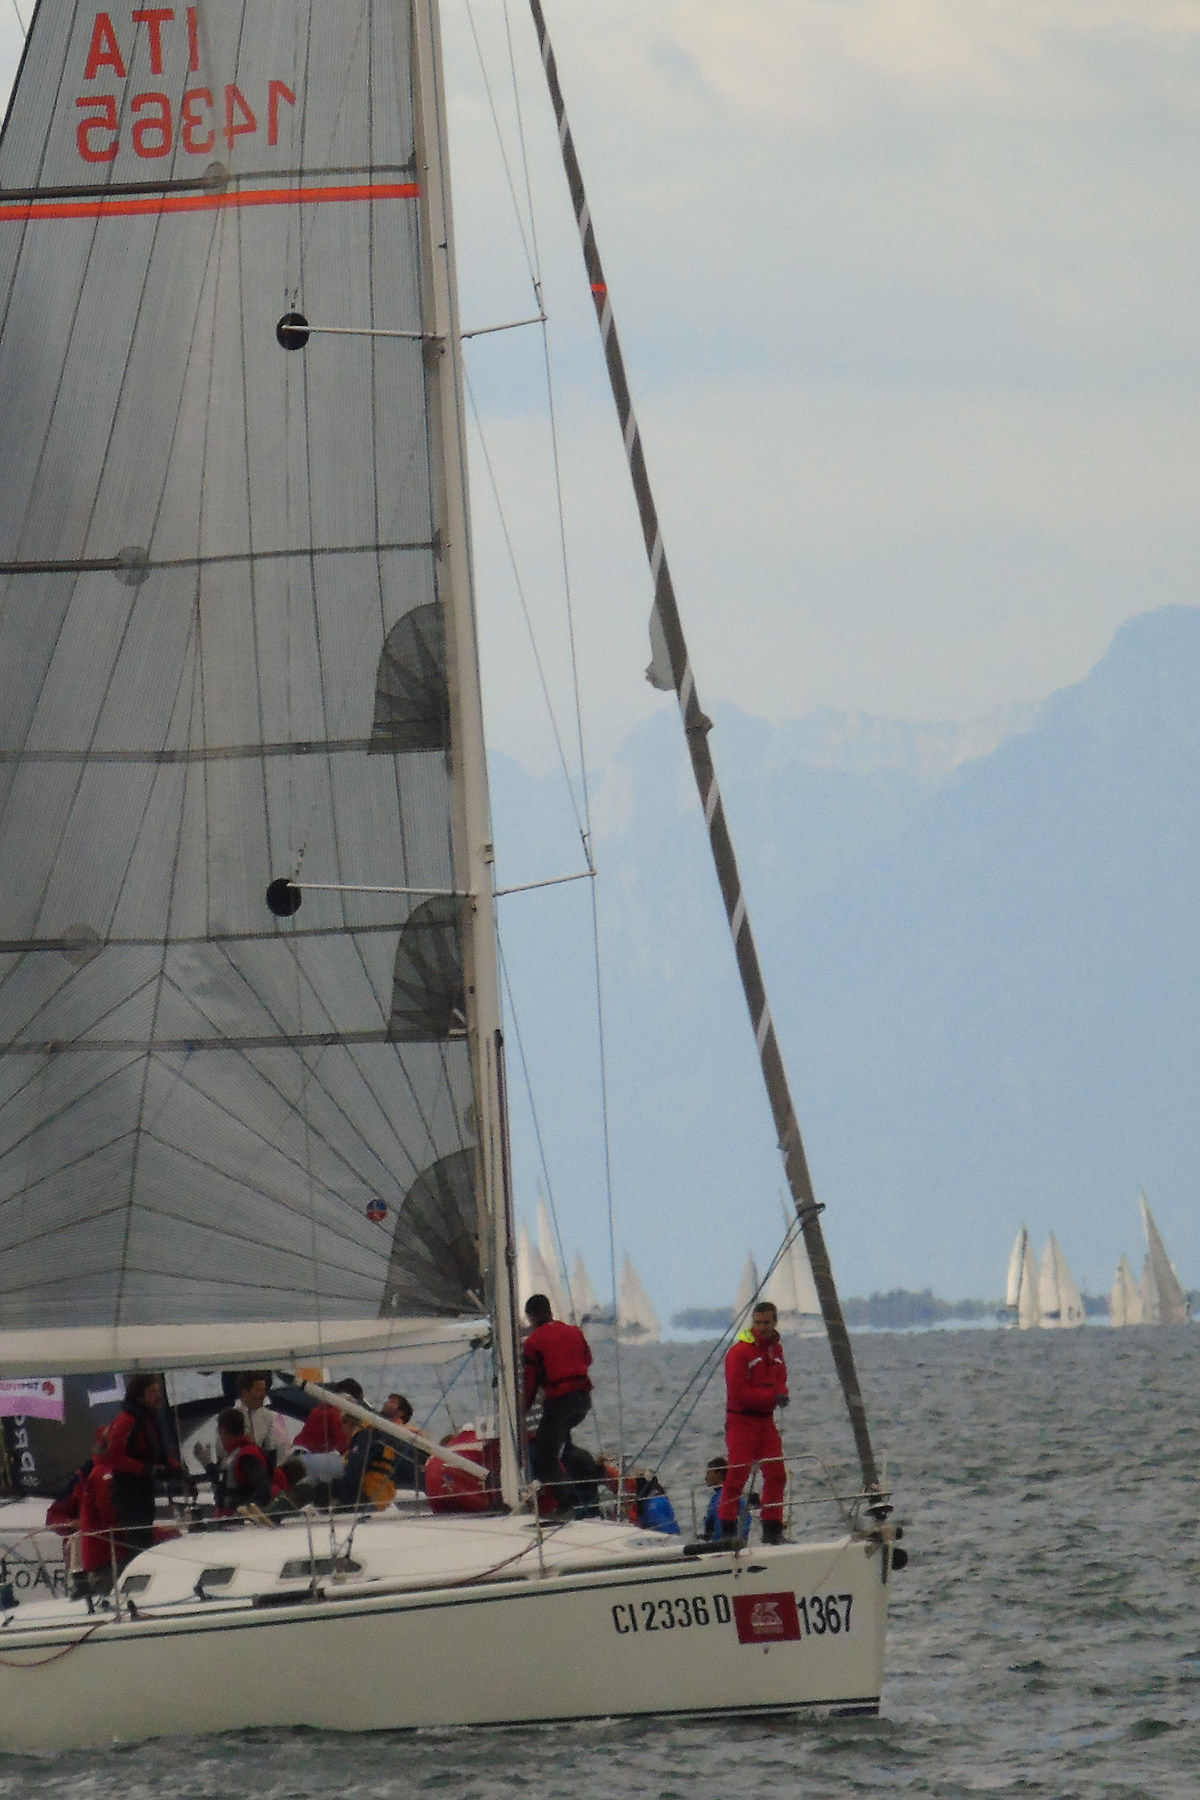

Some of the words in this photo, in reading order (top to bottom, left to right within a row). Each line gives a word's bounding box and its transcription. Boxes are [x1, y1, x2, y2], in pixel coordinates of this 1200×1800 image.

[642, 1596, 710, 1631] 2336
[713, 1594, 731, 1624] D
[798, 1595, 853, 1634] 1367
